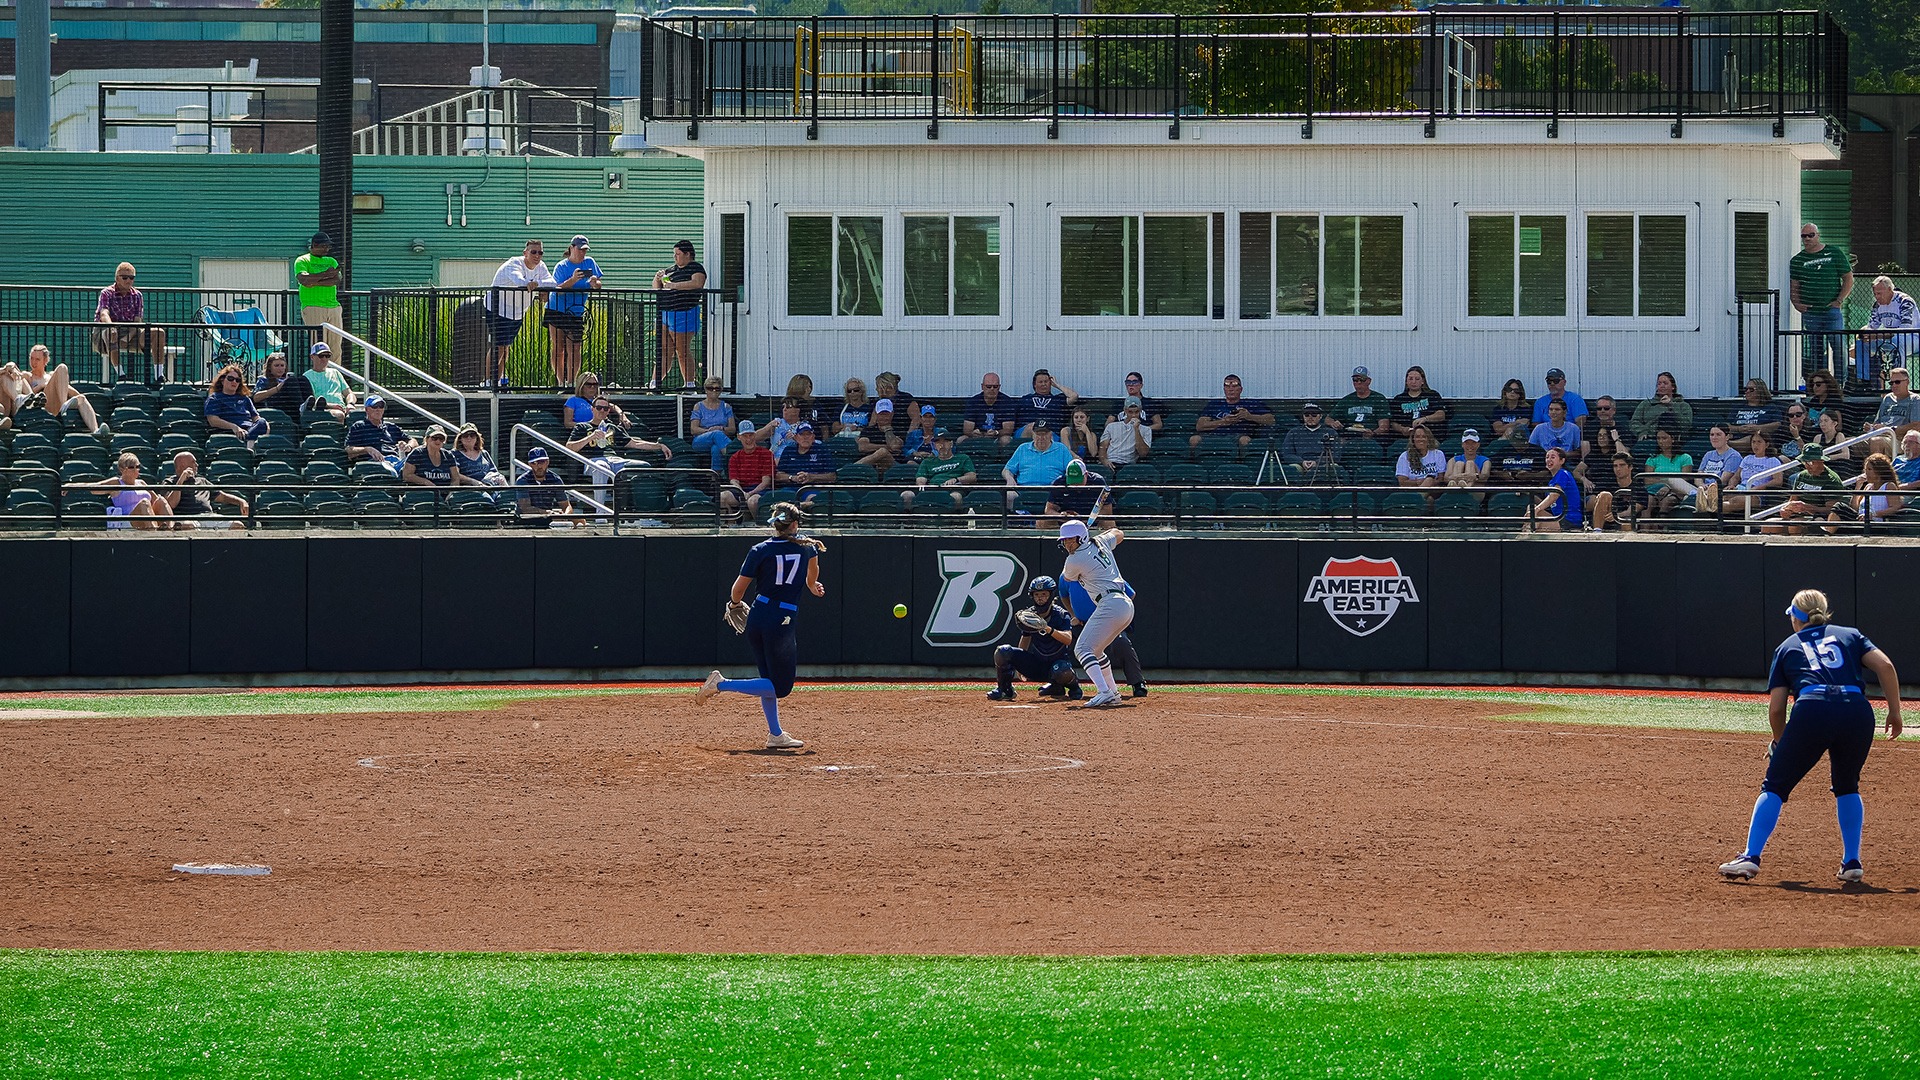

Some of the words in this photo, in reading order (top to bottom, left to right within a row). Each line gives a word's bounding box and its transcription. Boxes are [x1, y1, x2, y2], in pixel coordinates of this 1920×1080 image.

[775, 553, 801, 586] 17
[922, 550, 1028, 647] B
[1308, 578, 1415, 599] AMERICA
[1333, 596, 1391, 612] EAST
[1801, 635, 1844, 670] 15
